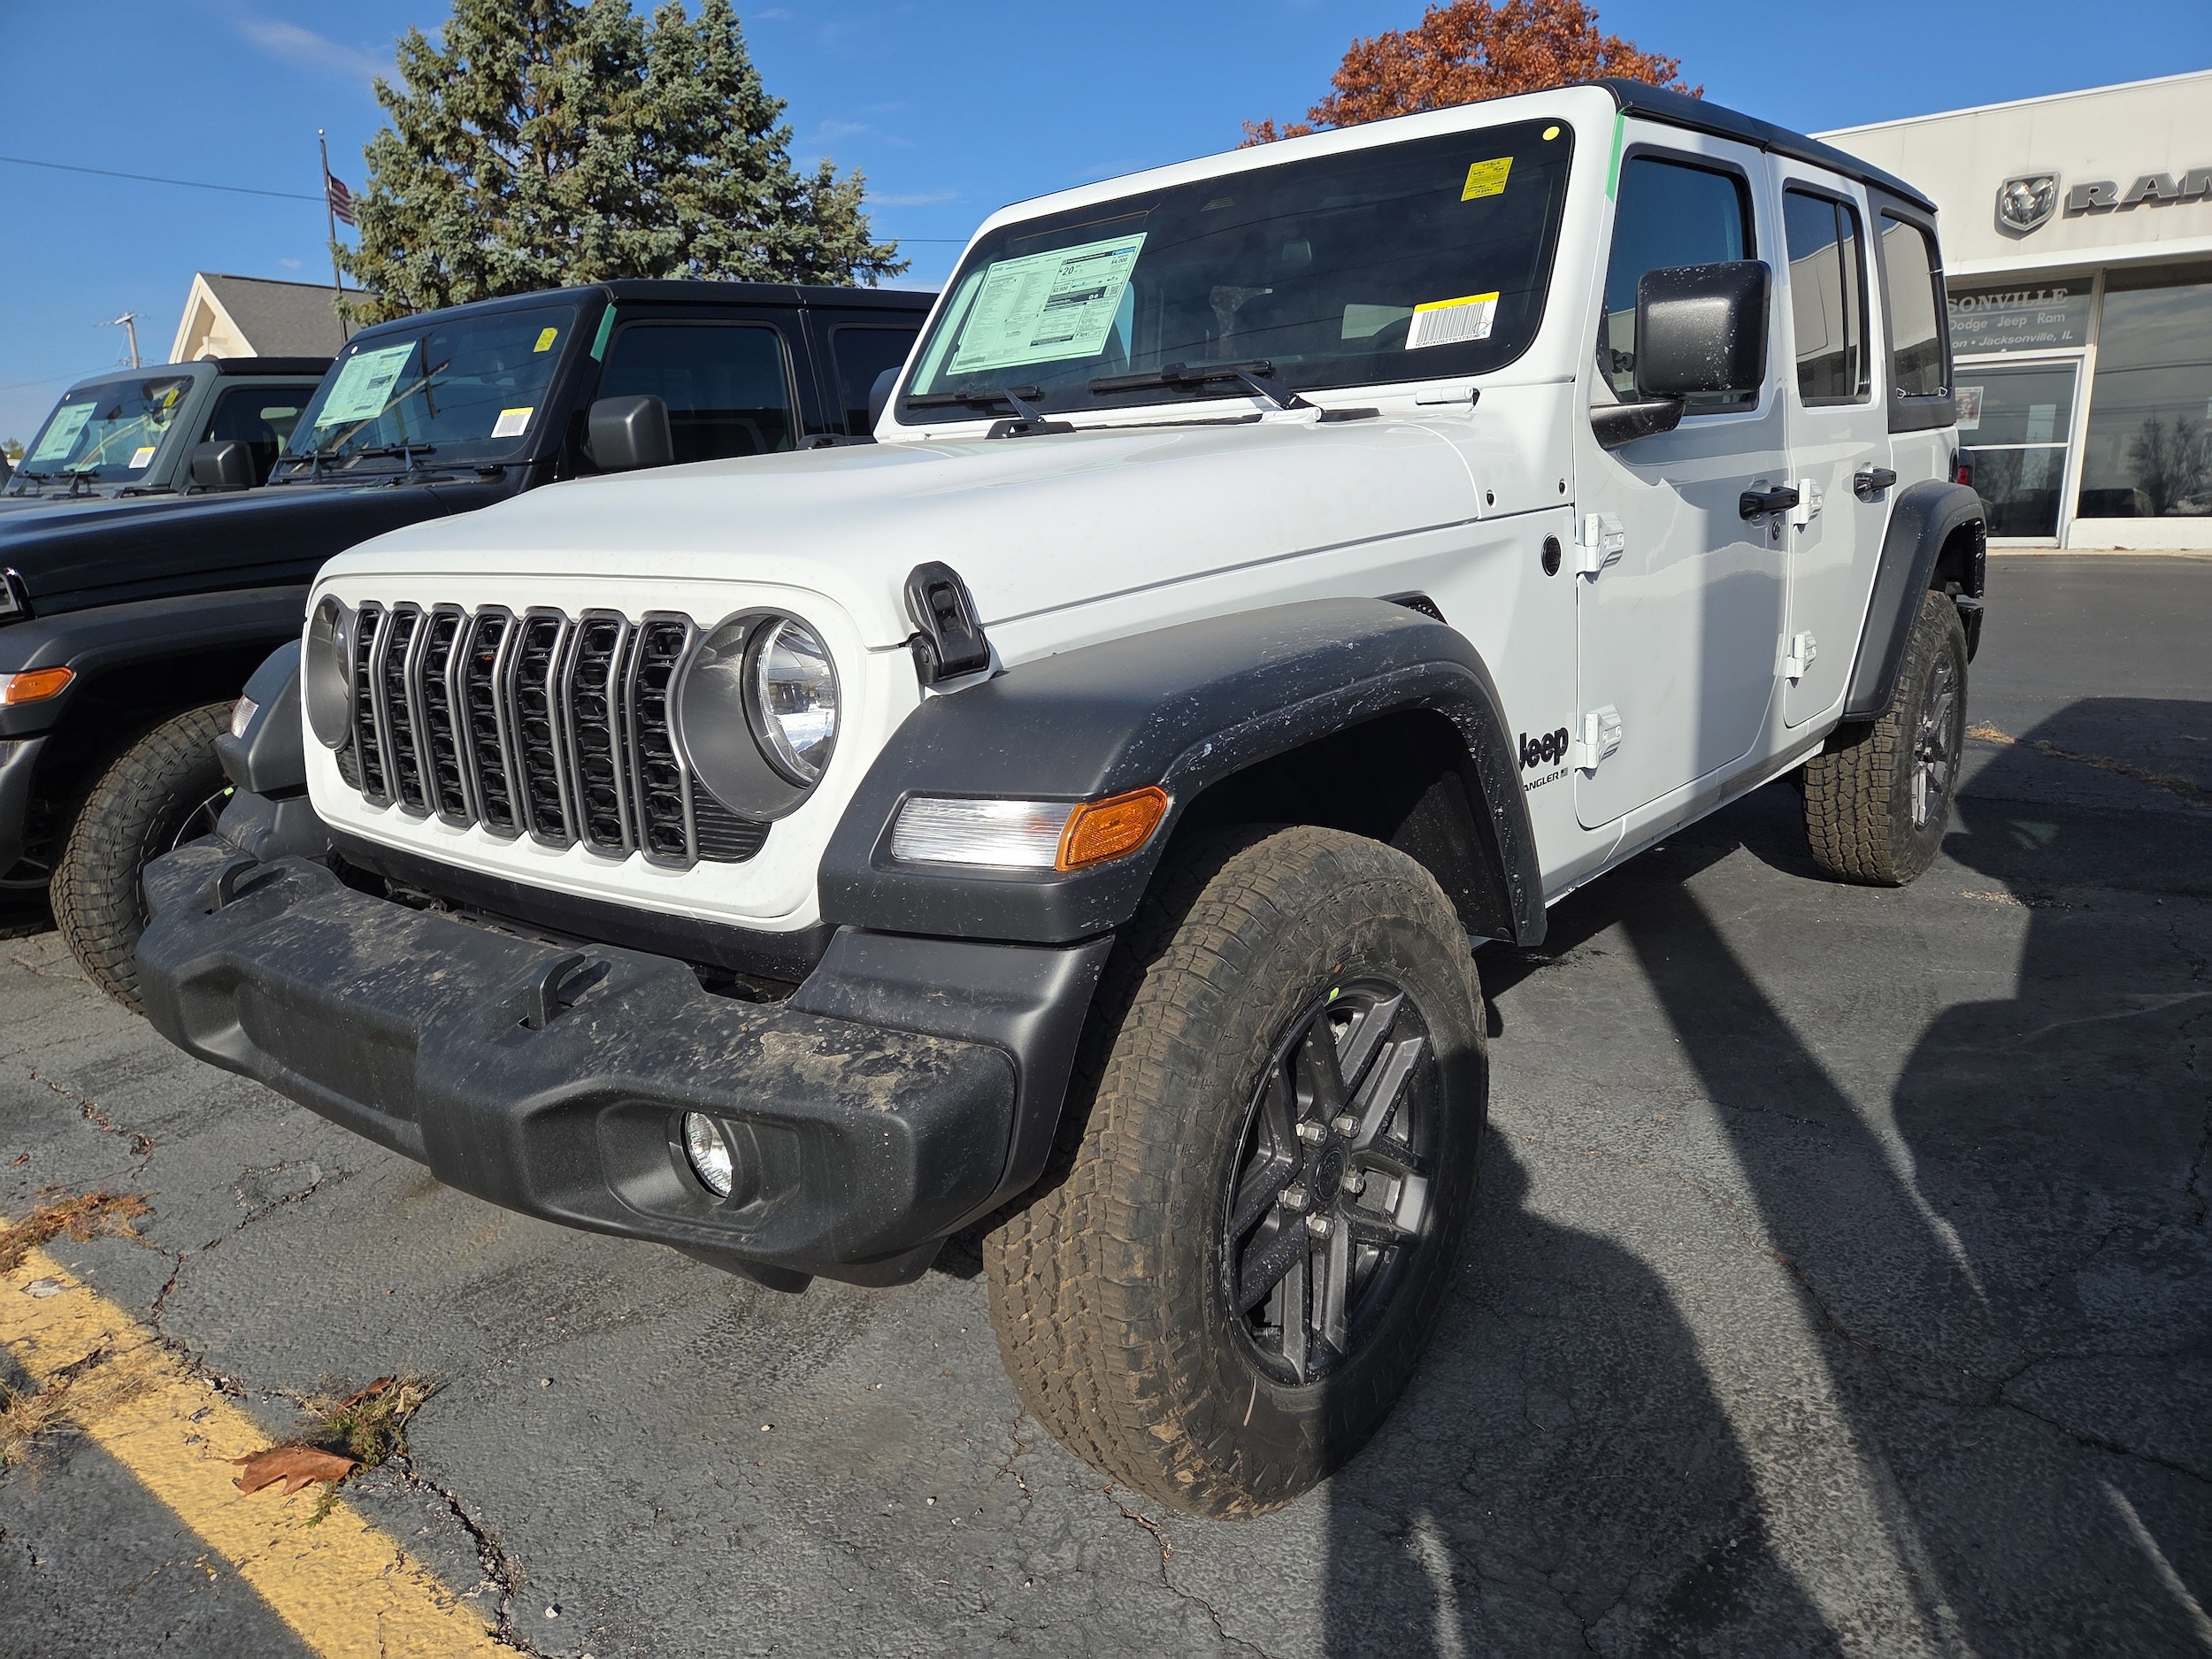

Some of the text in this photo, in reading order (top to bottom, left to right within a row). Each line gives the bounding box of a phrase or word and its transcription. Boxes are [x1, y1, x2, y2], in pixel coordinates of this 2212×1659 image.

[1062, 266, 1074, 275] 20
[1997, 315, 2028, 328] Jeep
[2037, 312, 2065, 324] Ram
[1979, 332, 2057, 346] Jacksonville,
[2061, 330, 2073, 340] IL
[1518, 726, 1569, 772] Jeep
